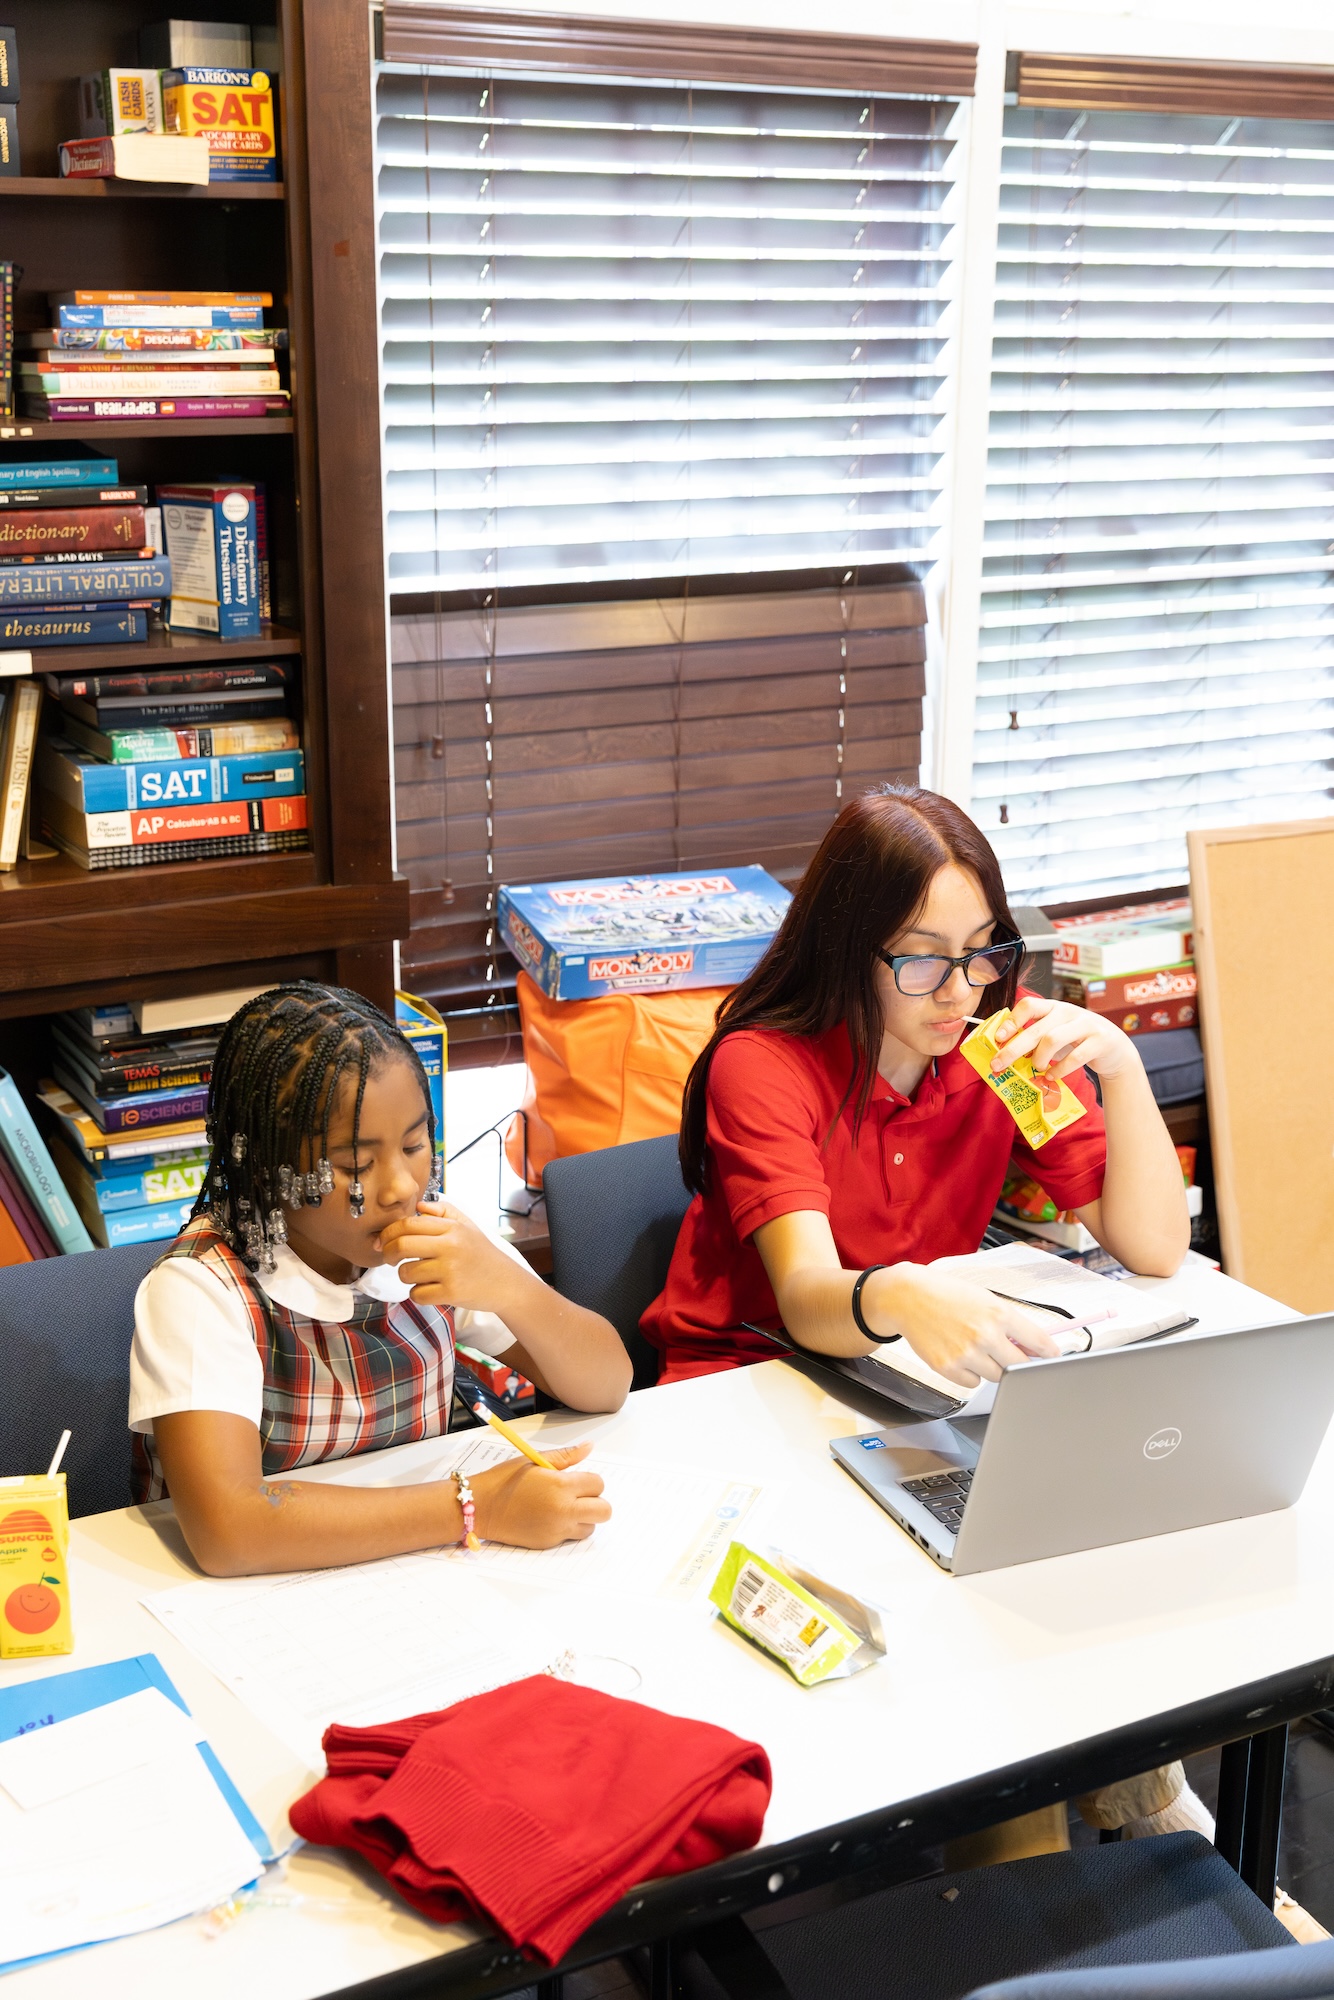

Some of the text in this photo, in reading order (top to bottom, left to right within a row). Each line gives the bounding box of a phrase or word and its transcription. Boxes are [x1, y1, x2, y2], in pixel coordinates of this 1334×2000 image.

[187, 70, 250, 86] BARRON'S
[120, 81, 131, 116] FLASH
[131, 81, 142, 117] CARDS
[145, 89, 156, 131] OLOGY
[192, 91, 269, 126] SAT
[201, 130, 262, 142] VOCABULARY
[209, 141, 264, 150] LASH CARDS
[70, 156, 104, 173] Dictionary
[144, 335, 192, 345] DESCUBRE
[79, 364, 111, 372] SPANISH
[67, 373, 161, 392] Dicho y hecho
[94, 401, 157, 415] Realidades
[16, 470, 24, 478] of
[25, 468, 51, 478] English
[52, 466, 80, 478] Spelling
[100, 490, 137, 500] BARRON'S
[57, 553, 77, 562] BAD
[78, 553, 104, 562] GUYS
[219, 525, 232, 605] Thesaurus
[235, 525, 249, 606] Dictionary
[68, 571, 165, 591] CULTURAL
[5, 619, 91, 637] thesaurus
[232, 675, 266, 685] PRINCIPLES
[141, 702, 224, 716] The Fall of Baghdad
[118, 735, 154, 750] Algebra
[11, 745, 30, 798] MUSIC
[140, 768, 207, 802] SAT
[96, 825, 127, 834] Princeton
[136, 814, 241, 836] AP Calculus AB & BC
[104, 831, 126, 840] Review
[591, 953, 692, 978] MONOPOLY
[123, 1064, 161, 1081] TEMAS
[127, 1072, 201, 1093] EARTH SCIENCE
[14, 1128, 54, 1197] MICROBIOLOGY
[145, 1164, 206, 1198] SAT
[1147, 1436, 1177, 1452] DELL
[711, 1520, 730, 1540] Write
[0, 1534, 54, 1544] SUNCUP
[0, 1547, 28, 1555] Apple
[695, 1547, 713, 1563] Two
